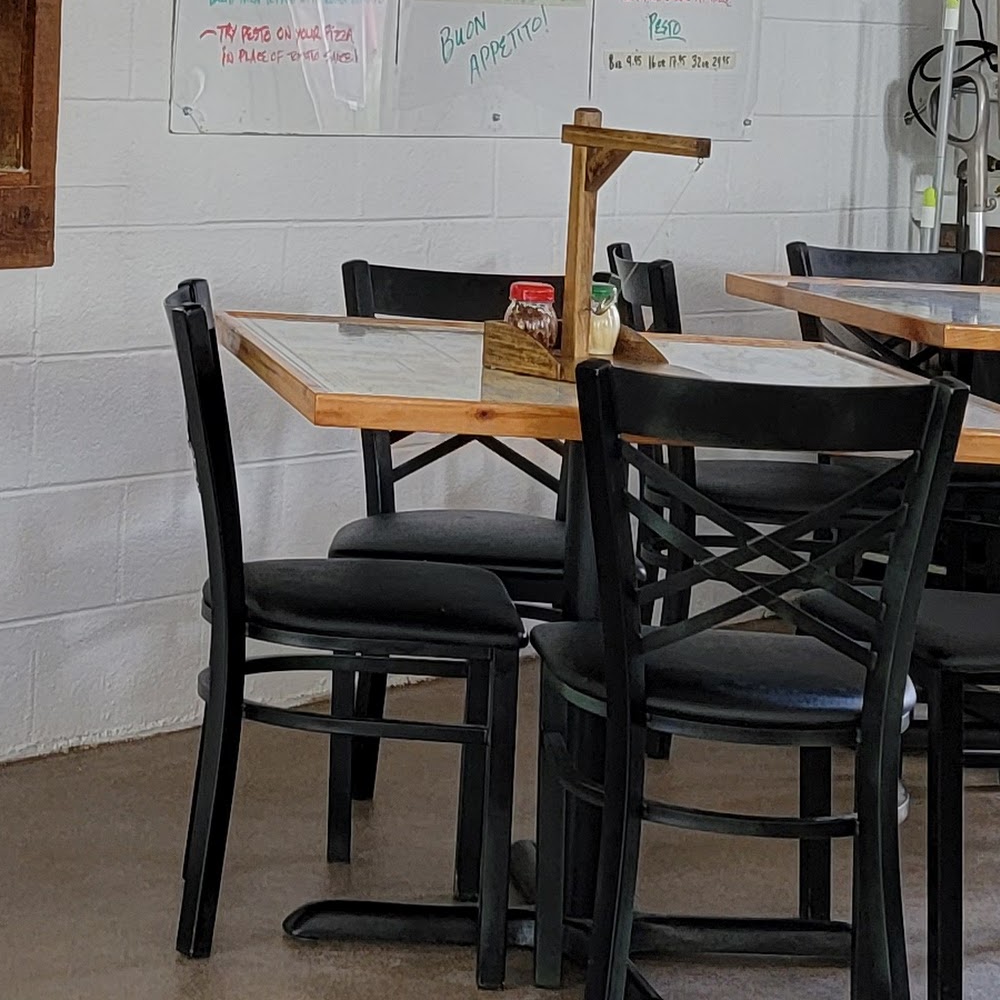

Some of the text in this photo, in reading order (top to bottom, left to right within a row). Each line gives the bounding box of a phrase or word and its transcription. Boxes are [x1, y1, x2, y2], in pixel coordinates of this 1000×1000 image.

[241, 25, 272, 42] PESTO
[277, 26, 291, 40] ON
[296, 27, 322, 42] YOUR
[440, 11, 487, 63] BUON
[649, 12, 681, 41] PESTO
[239, 49, 269, 64] PLACE
[470, 4, 549, 84] APPETITO!
